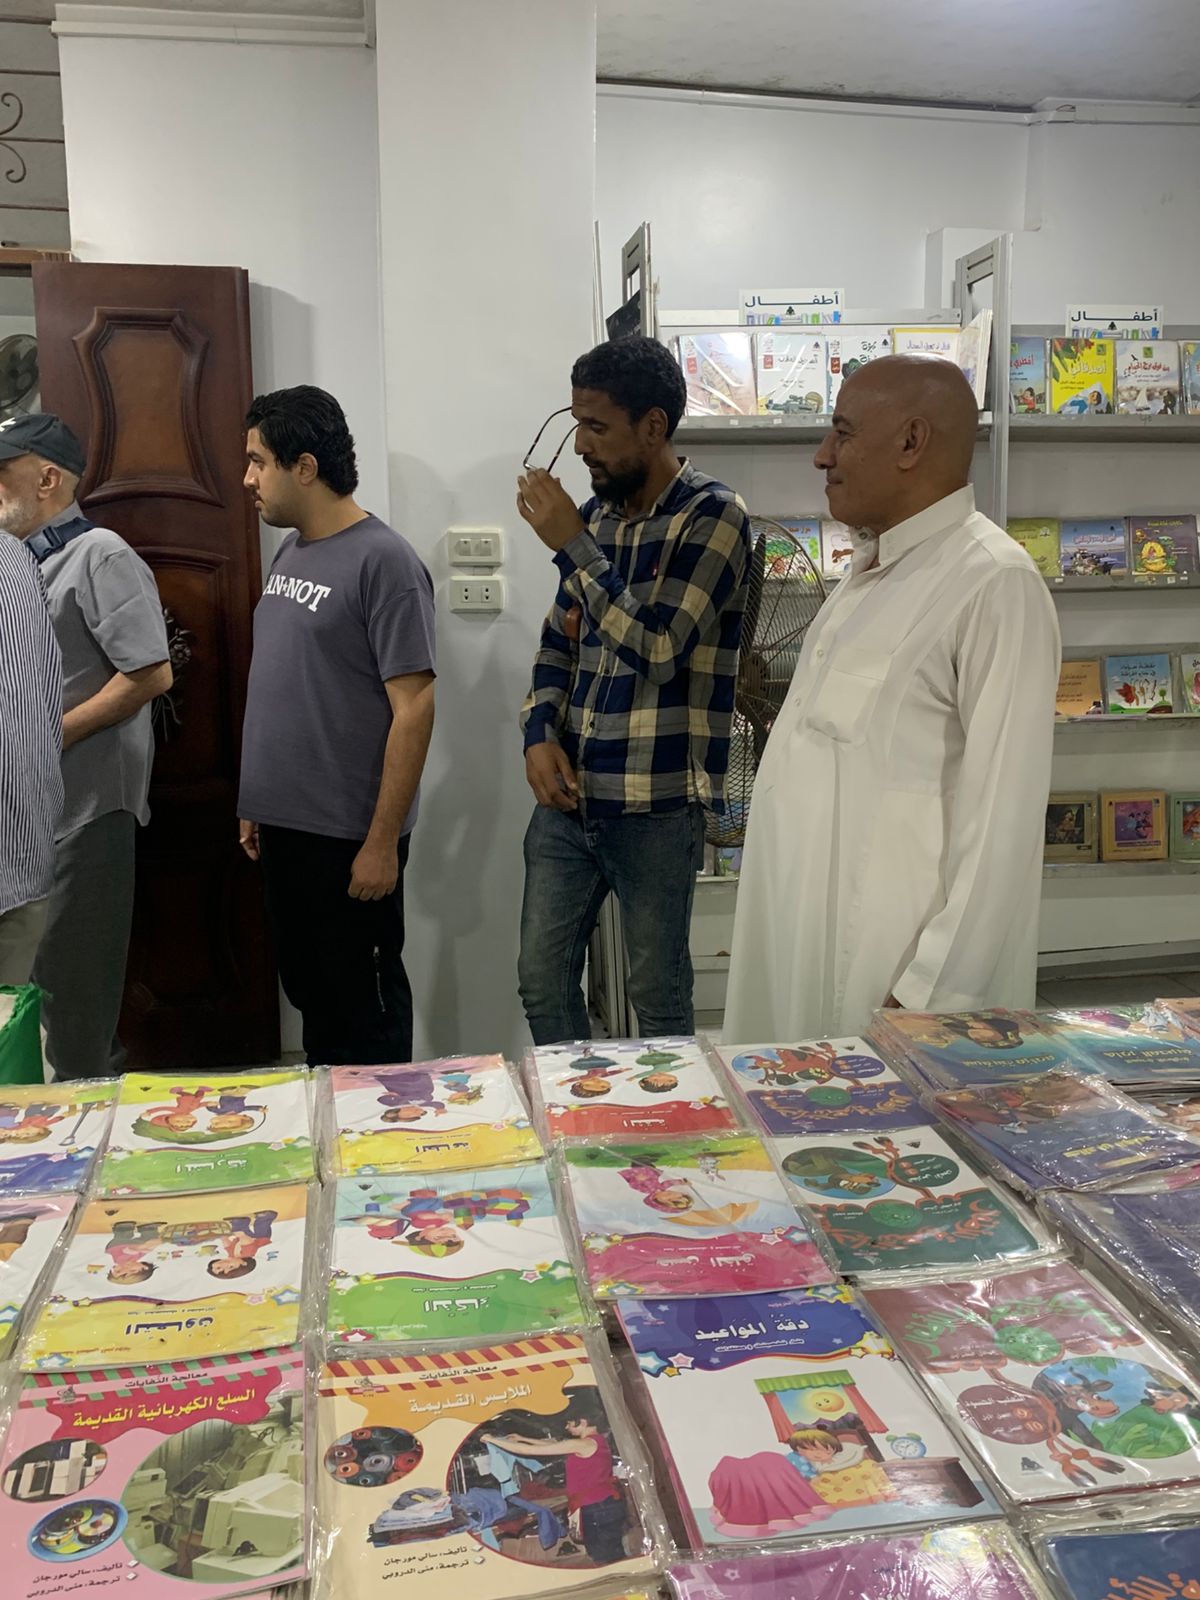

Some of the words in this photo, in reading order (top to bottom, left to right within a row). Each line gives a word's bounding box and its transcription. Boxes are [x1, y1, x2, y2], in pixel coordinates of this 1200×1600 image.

[745, 291, 839, 307] أطفال
[1071, 309, 1158, 322] أطفال
[284, 577, 332, 613] NOT
[415, 1141, 470, 1155] الطاعة
[175, 1158, 248, 1176] المشاركة
[424, 1297, 489, 1318] الذكاء
[125, 1316, 214, 1341] التعاون
[695, 1320, 767, 1342] المواعيد
[774, 1316, 810, 1332] دقة
[172, 1372, 208, 1383] معالجة
[419, 1369, 460, 1380] النفايات
[463, 1365, 498, 1375] معالجة
[125, 1376, 169, 1388] النفايات
[216, 1389, 256, 1411] السلع
[409, 1392, 476, 1414] القديمة
[479, 1384, 532, 1407] الملابس
[137, 1396, 213, 1420] الكهربائية
[72, 1408, 133, 1430] القديمة
[383, 1555, 416, 1566] مورجان
[32, 1573, 68, 1584] مورجان
